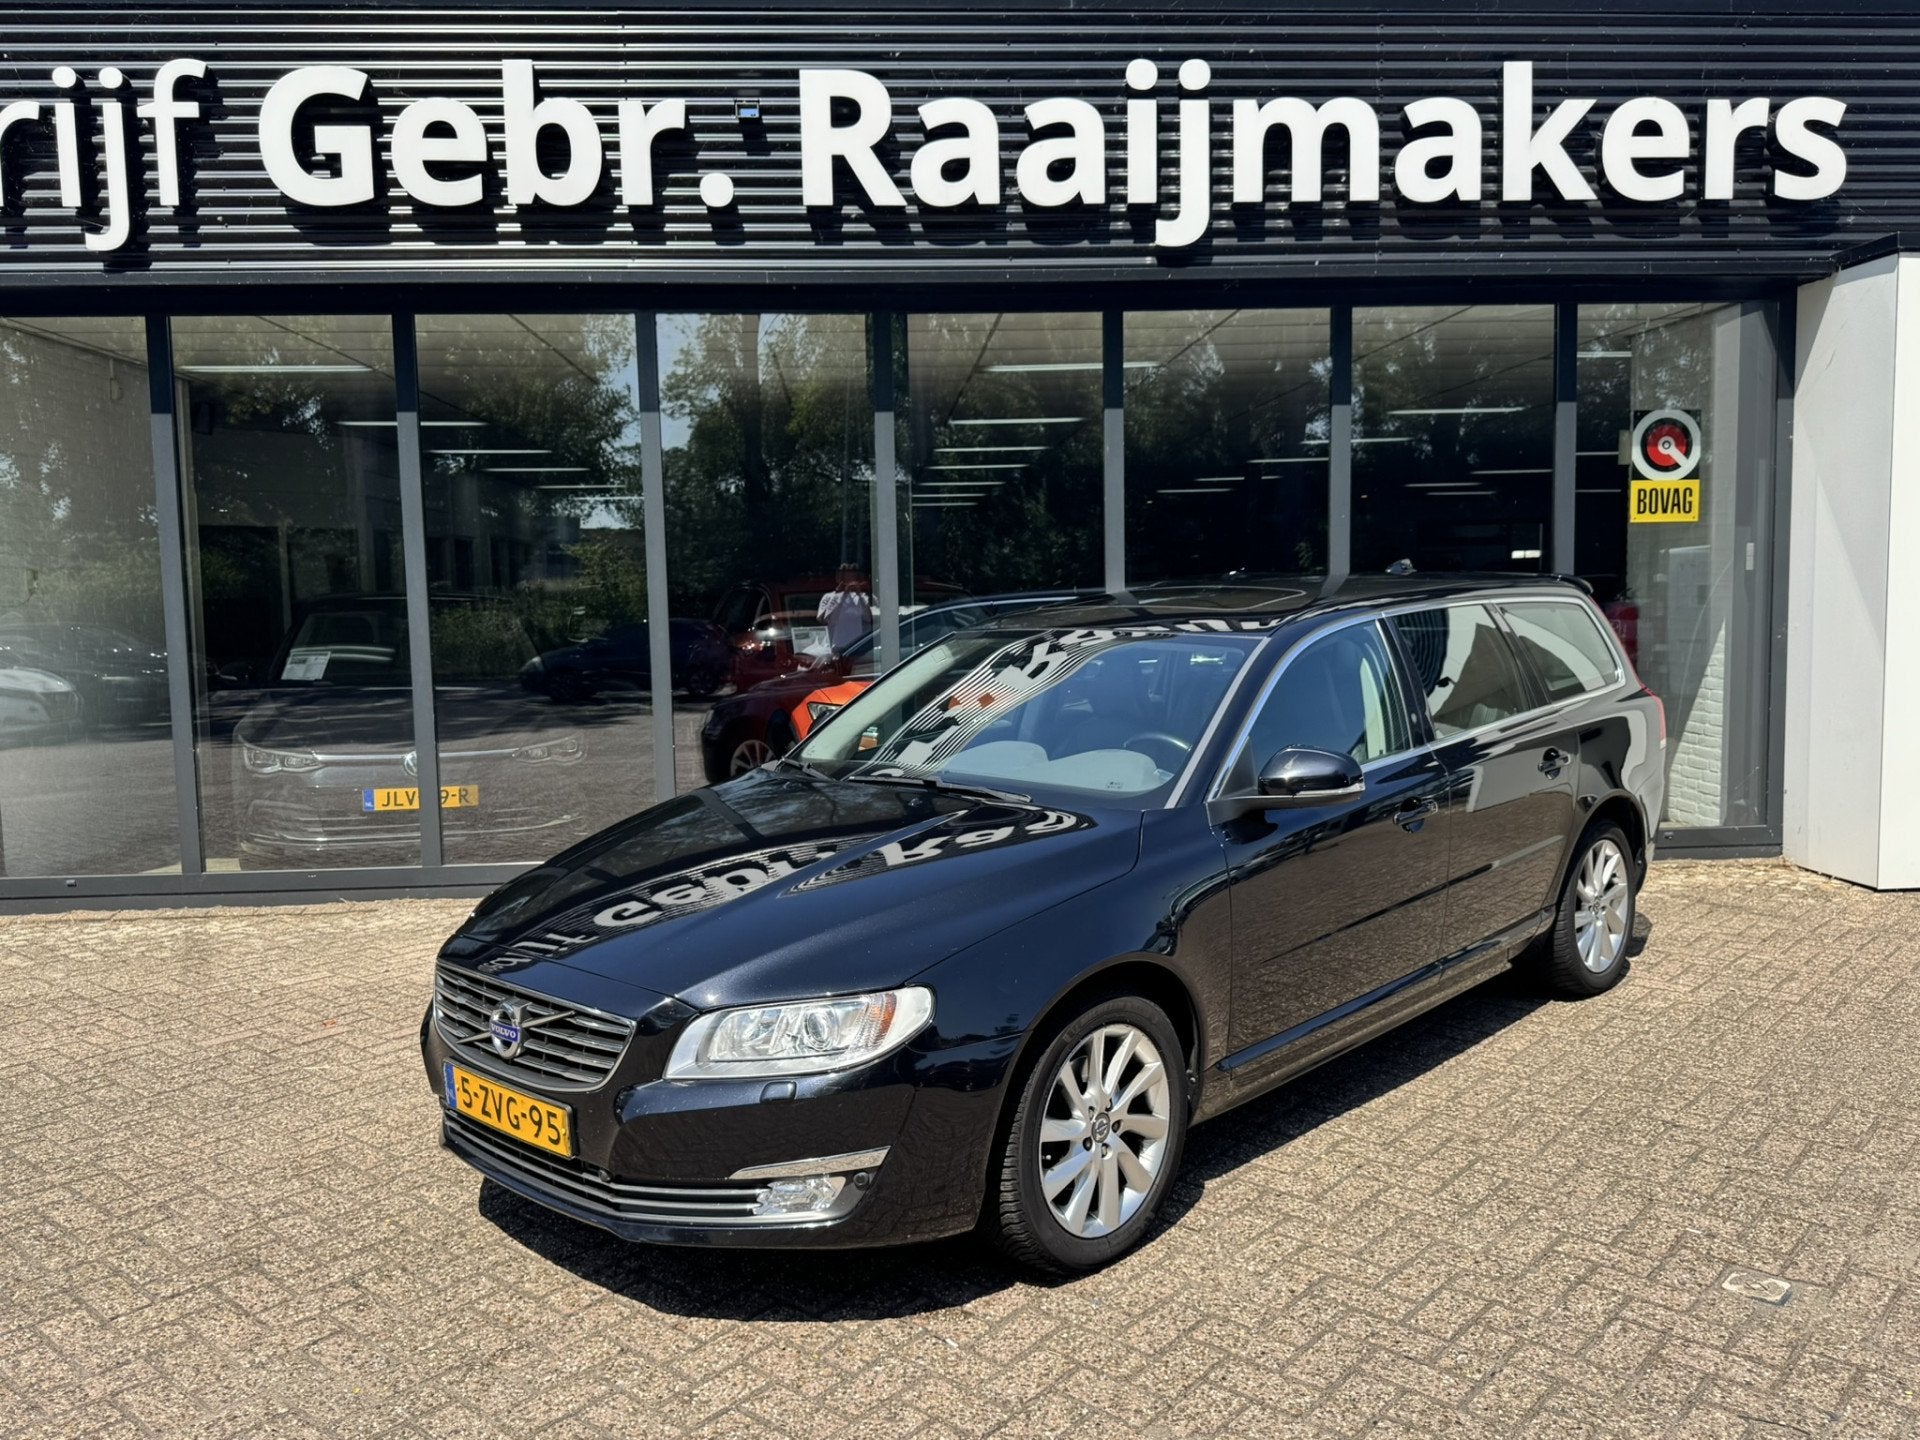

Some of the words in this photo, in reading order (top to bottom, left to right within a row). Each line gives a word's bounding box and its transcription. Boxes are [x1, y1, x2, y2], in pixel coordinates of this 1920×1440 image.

[258, 59, 735, 207] Gebr.
[799, 58, 1848, 247] Raaijmakers
[1637, 487, 1693, 514] BOVAG
[381, 788, 472, 807] JLV9-R
[491, 1023, 517, 1039] VOLVO
[461, 1076, 561, 1146] 5-ZVG-95
